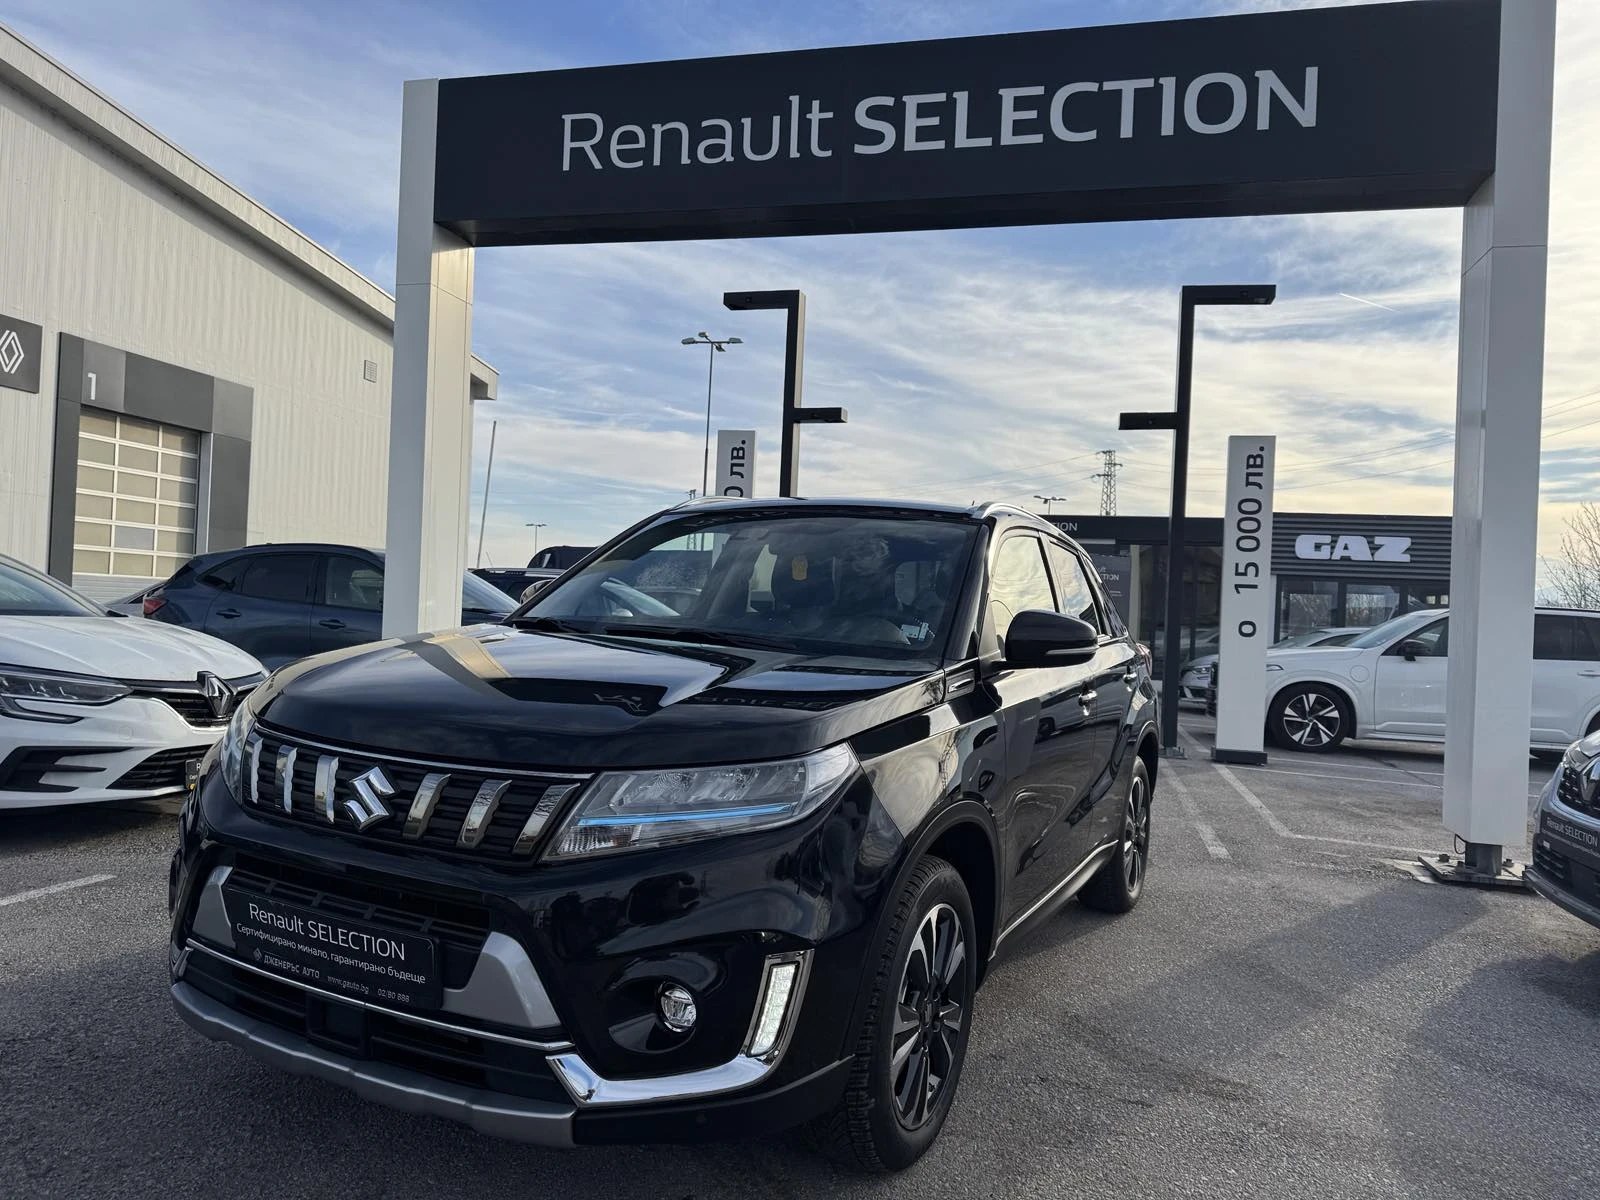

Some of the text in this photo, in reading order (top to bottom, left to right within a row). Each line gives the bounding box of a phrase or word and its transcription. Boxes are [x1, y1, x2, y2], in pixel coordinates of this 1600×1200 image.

[561, 66, 1318, 171] Renault SELECTION
[87, 372, 97, 401] 1
[1245, 446, 1265, 490] лв.
[1236, 498, 1262, 553] 000
[1294, 534, 1412, 563] GAZ
[1234, 562, 1260, 595] 15
[1565, 825, 1598, 847] SELECTION
[248, 902, 405, 961] Renault SELECTION
[236, 922, 426, 984] Сертифицирано минало, гарантирано бъдеще
[263, 955, 300, 974] ДЖЕНЕРЪС
[302, 967, 320, 979] АУТО
